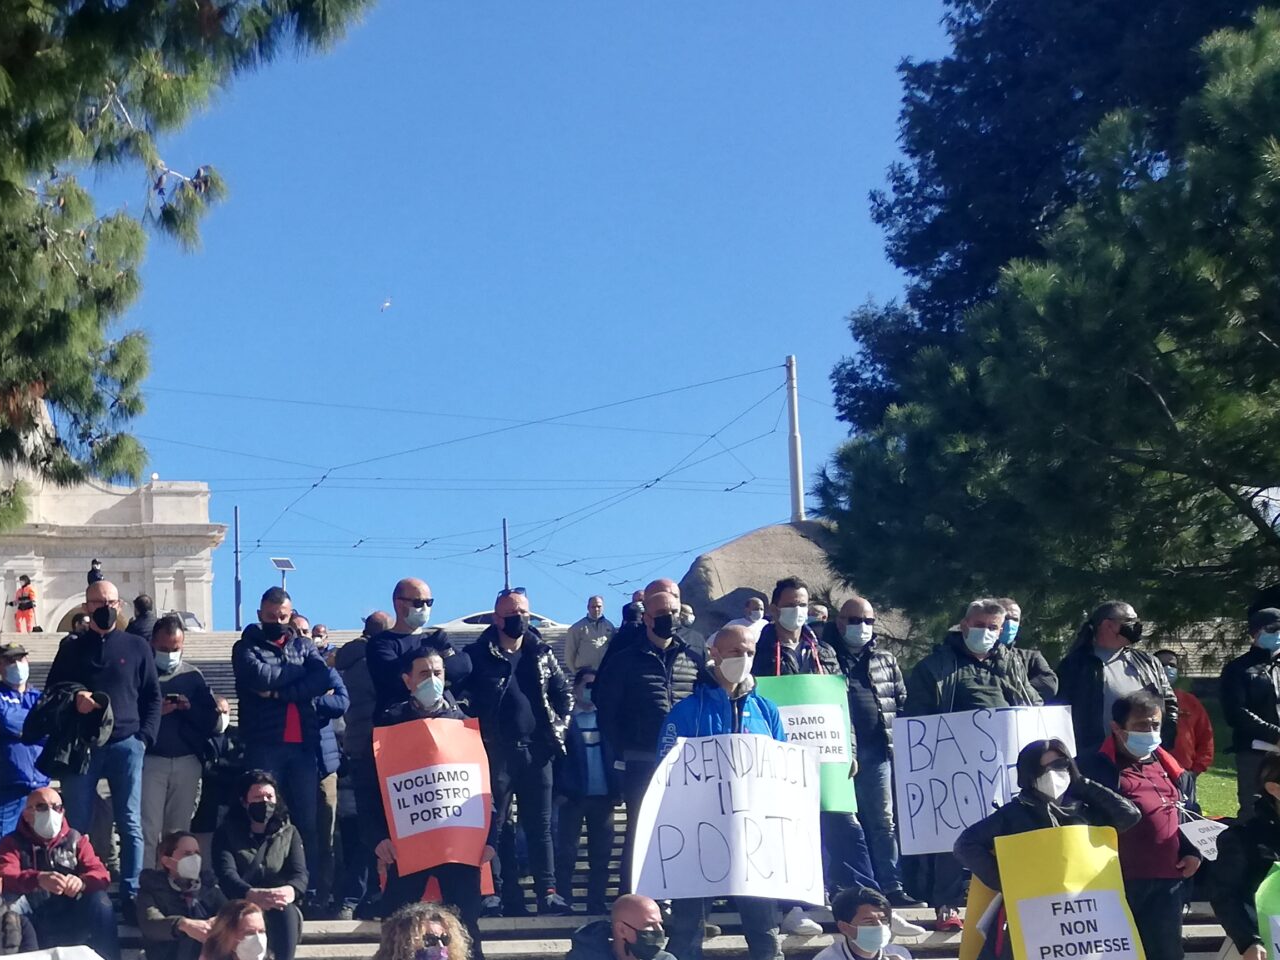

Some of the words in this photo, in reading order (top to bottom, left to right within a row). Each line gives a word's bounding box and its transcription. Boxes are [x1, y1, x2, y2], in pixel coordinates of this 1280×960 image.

[787, 716, 825, 726] SIAMO
[783, 730, 827, 741] TANCHI
[830, 731, 840, 740] DI
[392, 770, 470, 793] VOGLIAMO
[397, 797, 411, 810] IL
[413, 787, 470, 805] NOSTRO
[717, 781, 751, 815] IL
[409, 805, 462, 826] PORTO
[657, 815, 816, 892] PORTO
[1051, 898, 1098, 916] FATTI
[1060, 919, 1098, 936] NON
[1039, 937, 1131, 960] PROMESSE
